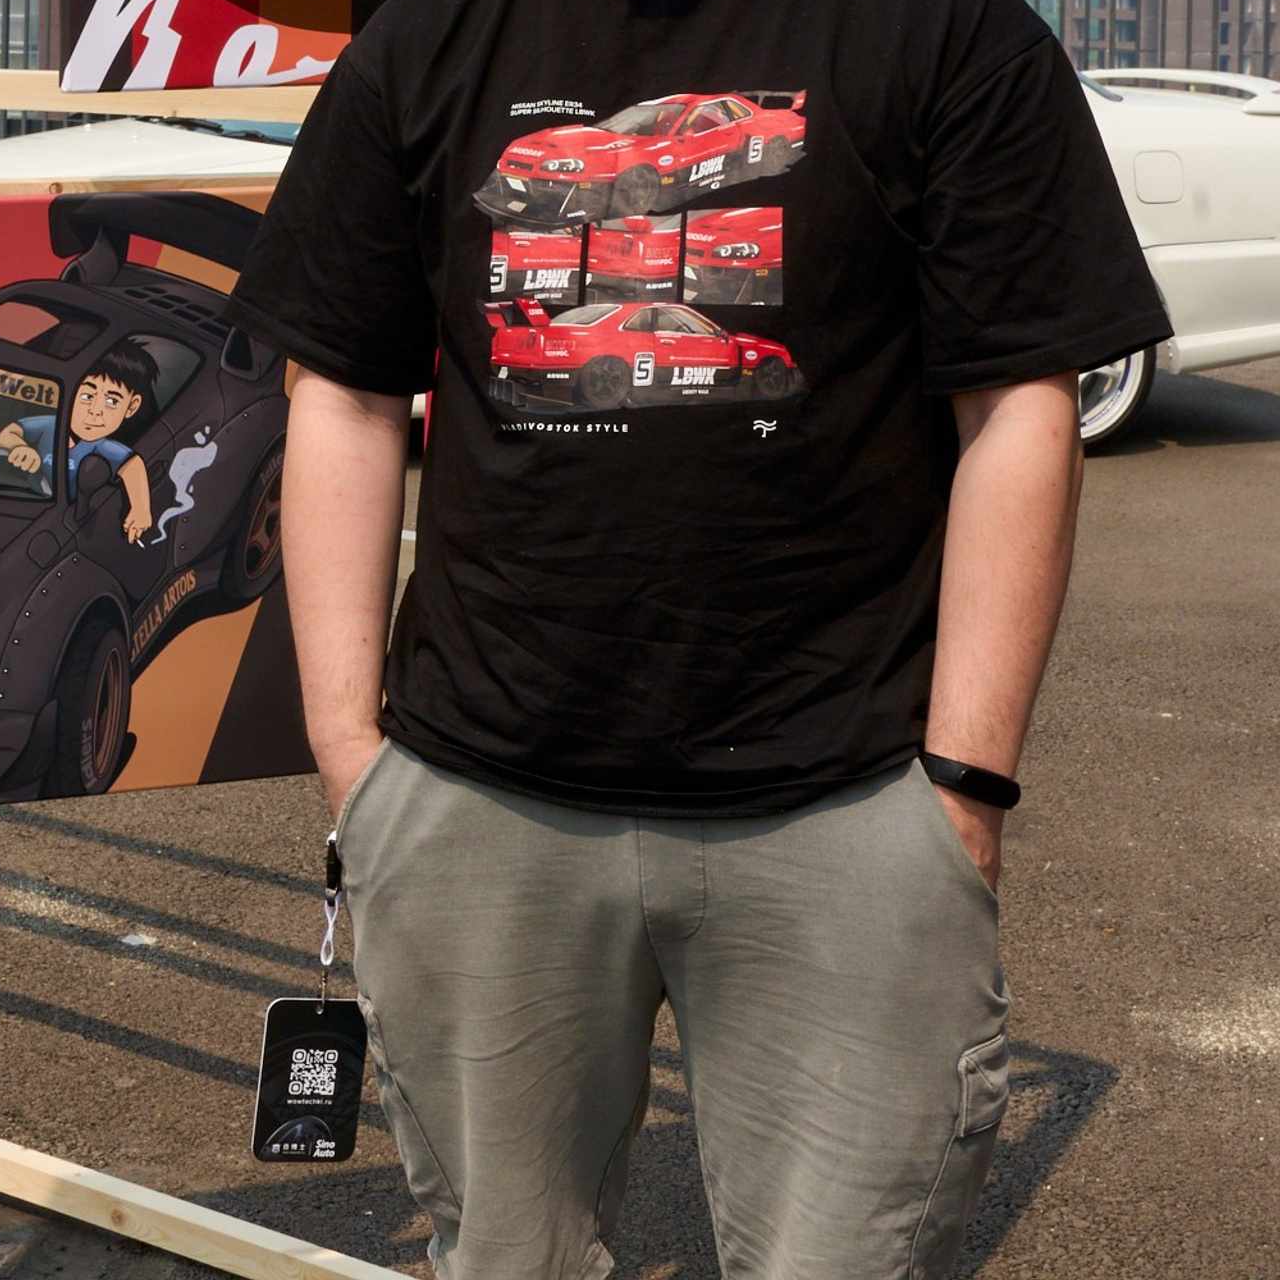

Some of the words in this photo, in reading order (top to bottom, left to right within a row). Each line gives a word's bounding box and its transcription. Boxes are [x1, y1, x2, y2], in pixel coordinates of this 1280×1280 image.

[510, 108, 532, 116] SUPER
[511, 102, 536, 110] NISSAN
[750, 140, 761, 160] 5
[689, 155, 725, 182] LBWK
[523, 269, 572, 290] LBWK
[636, 360, 650, 380] 5
[671, 367, 717, 385] LBWK
[586, 424, 629, 433] STYLE
[164, 569, 196, 618] ARTOIS
[313, 1149, 335, 1157] Auto
[315, 1140, 335, 1149] Sino
